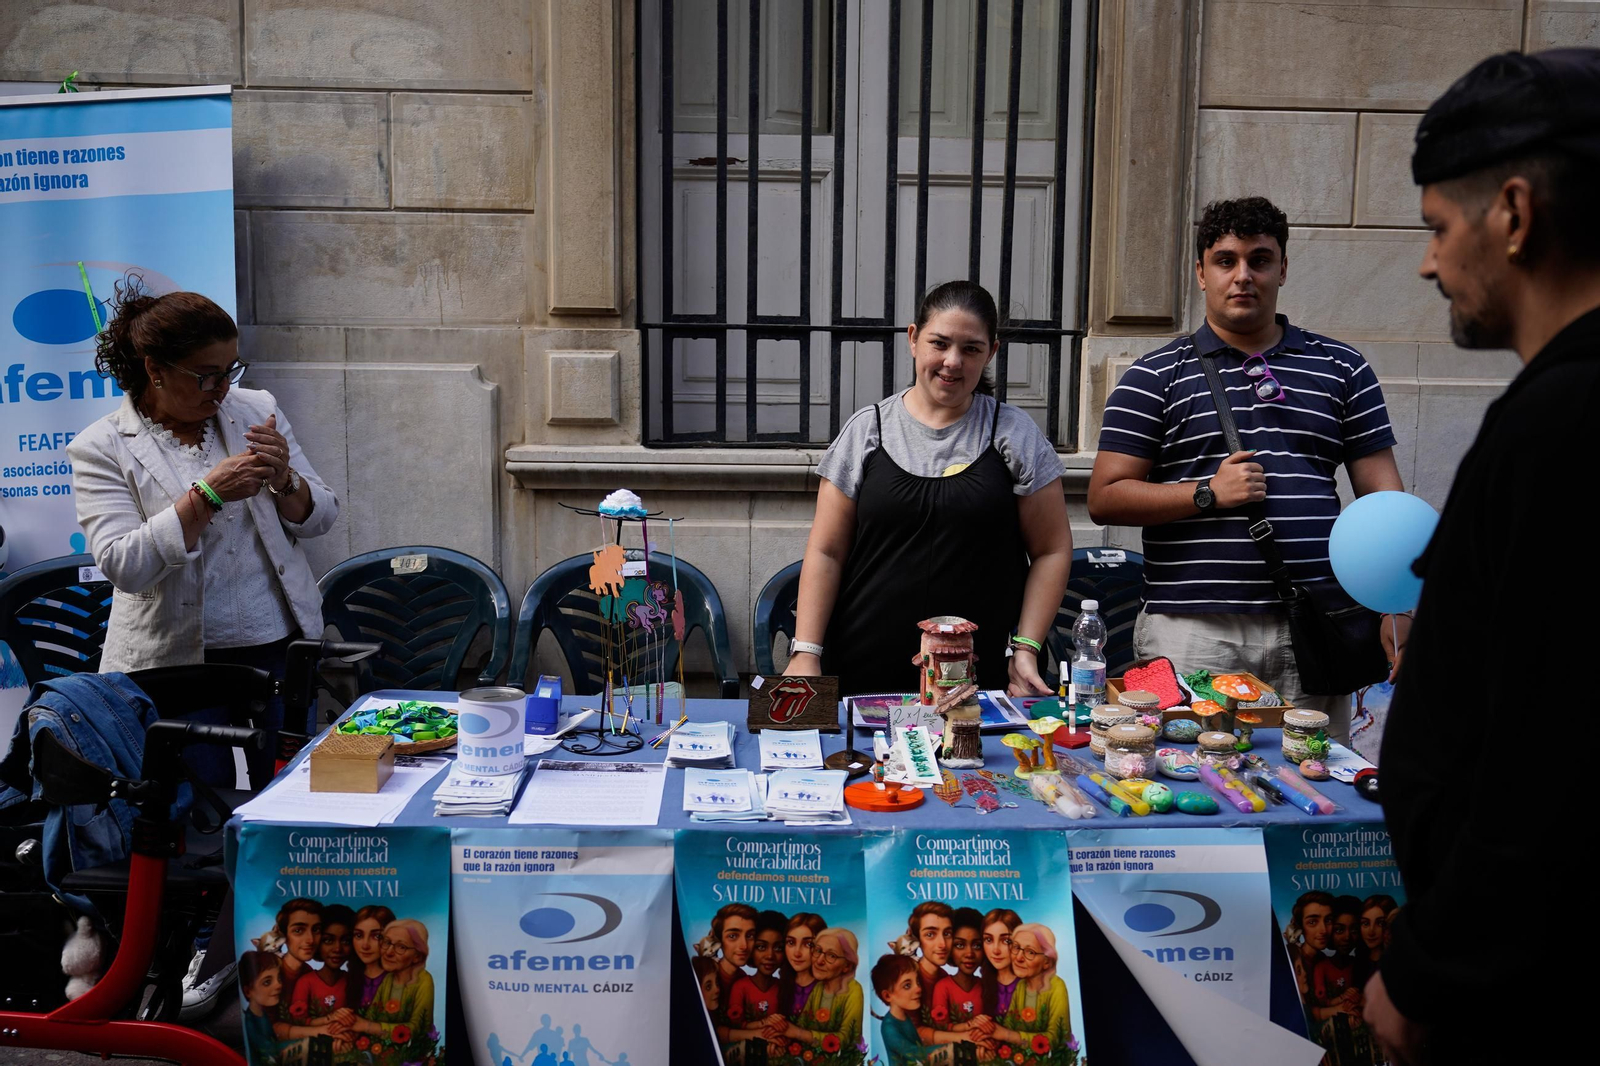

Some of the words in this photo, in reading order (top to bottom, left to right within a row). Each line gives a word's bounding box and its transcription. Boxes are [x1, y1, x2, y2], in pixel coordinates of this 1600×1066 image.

[16, 149, 59, 166] tiene
[63, 146, 125, 164] razones
[34, 173, 89, 191] ignora
[43, 484, 71, 496] con
[893, 708, 904, 725] 2
[464, 764, 500, 773] MENTAL
[288, 832, 389, 853] Compartimos
[916, 834, 1010, 854] Compartimos
[1302, 827, 1391, 847] Compartimos
[288, 847, 389, 864] vulnerabilidad
[463, 848, 471, 859] El
[473, 849, 511, 860] corazón
[514, 849, 539, 860] tiene
[541, 850, 579, 860] razones
[726, 837, 822, 858] Compartimos
[1075, 848, 1111, 860] corazón
[1113, 848, 1137, 858] tiene
[1140, 849, 1176, 859] razones
[1302, 841, 1392, 858] vulnerabilidad
[726, 853, 822, 871] vulnerabilidad
[916, 850, 1011, 866] vulnerabilidad
[1069, 864, 1084, 873] que
[1085, 862, 1094, 871] la
[1096, 860, 1121, 871] razón
[1123, 860, 1154, 871] ignora
[1295, 861, 1359, 870] defendamos
[280, 866, 350, 876] defendamos
[353, 866, 398, 876] nuestra
[463, 862, 481, 872] que
[483, 862, 492, 872] la
[494, 862, 521, 872] razón
[523, 862, 555, 873] ignora
[910, 868, 977, 878] defendamos
[979, 868, 1020, 878] nuestra
[717, 870, 785, 882] defendamos
[788, 873, 830, 883] nuestra
[1291, 874, 1341, 891] SALUD
[275, 880, 330, 898] SALUD
[335, 879, 405, 898] MENTAL
[712, 884, 765, 903] SALUD
[770, 886, 838, 906] MENTAL
[906, 882, 958, 900] SALUD
[964, 882, 1030, 901] MENTAL
[487, 950, 634, 971] afemen
[1141, 946, 1234, 963] men
[1194, 971, 1234, 982] CÁDIZ
[488, 980, 530, 993] SALUD
[533, 982, 589, 993] MENTAL
[592, 981, 634, 993] CÁDIZ
